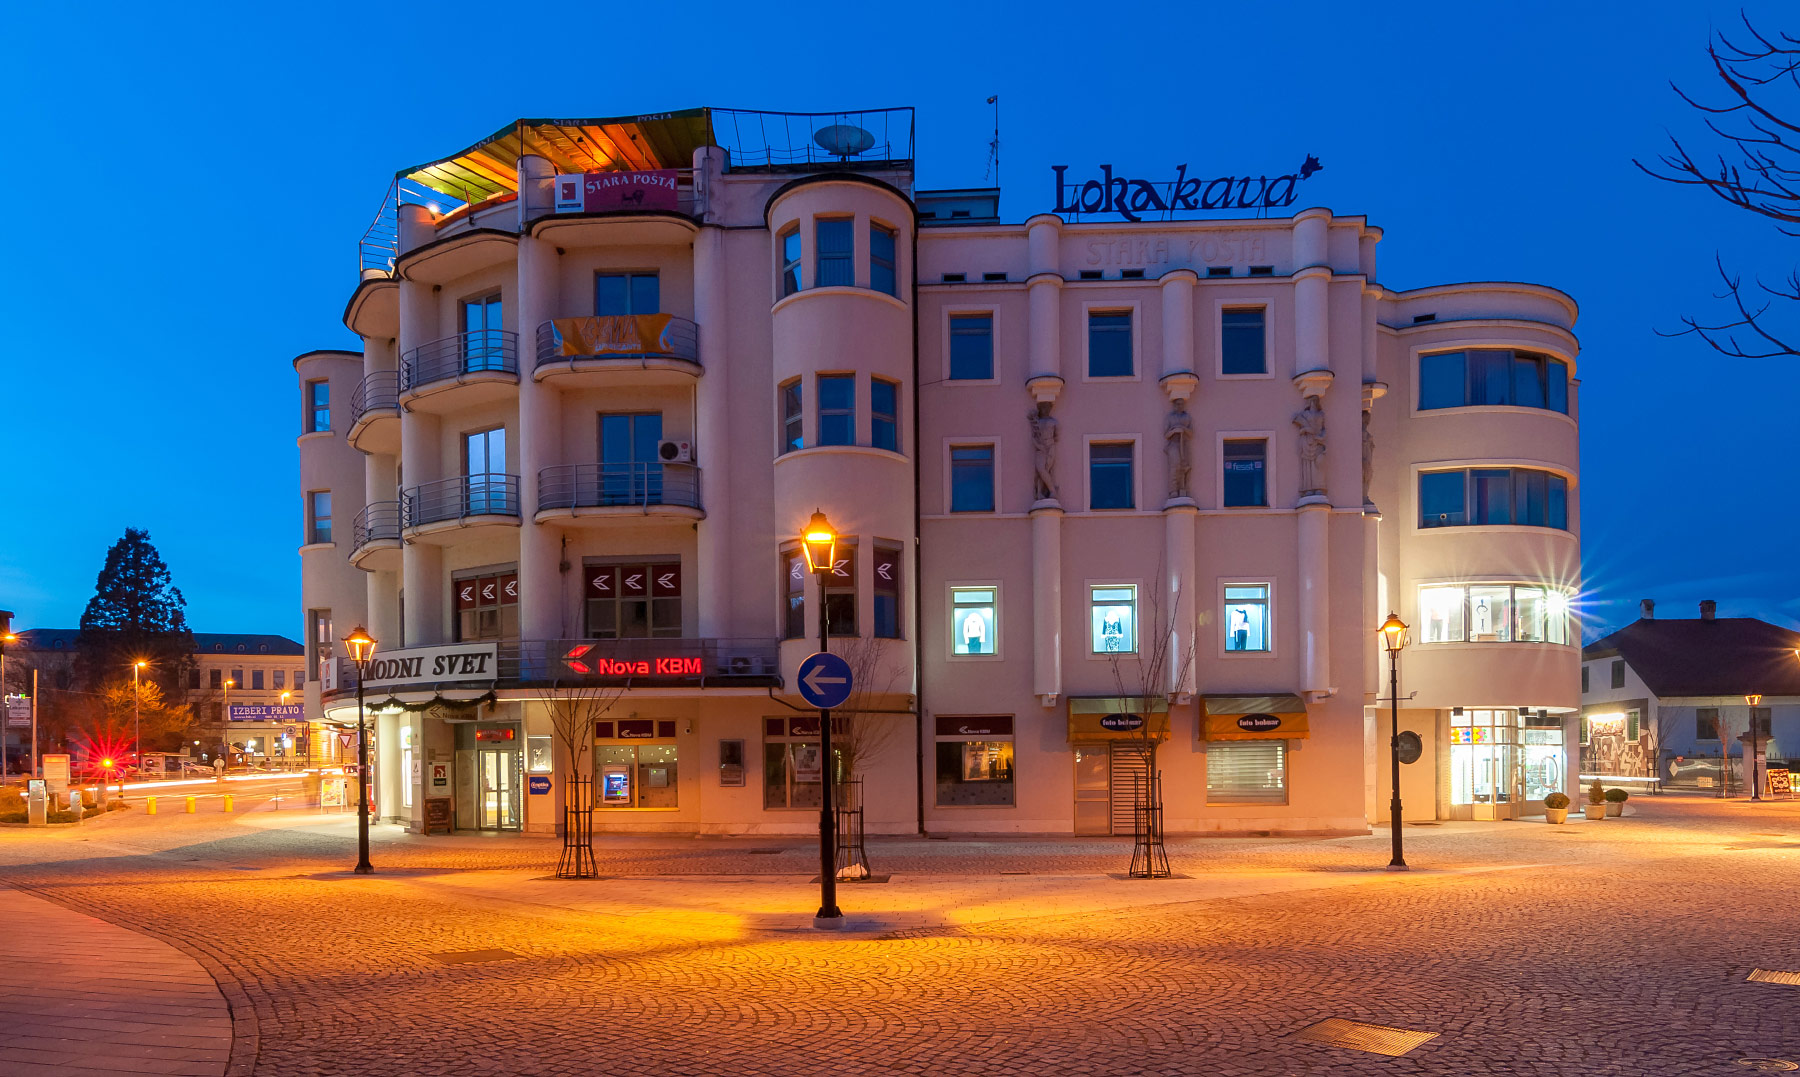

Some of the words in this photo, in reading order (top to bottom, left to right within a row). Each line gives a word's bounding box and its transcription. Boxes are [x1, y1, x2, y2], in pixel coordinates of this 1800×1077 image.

[585, 175, 629, 194] STARA
[633, 172, 676, 191] POŠTA
[1086, 238, 1169, 265] STARA
[363, 656, 425, 682] MODNI
[432, 652, 493, 676] SVET
[599, 658, 649, 675] Nova
[655, 658, 702, 674] KBM
[233, 707, 267, 715] IZBERI
[271, 706, 299, 715] PRAVO
